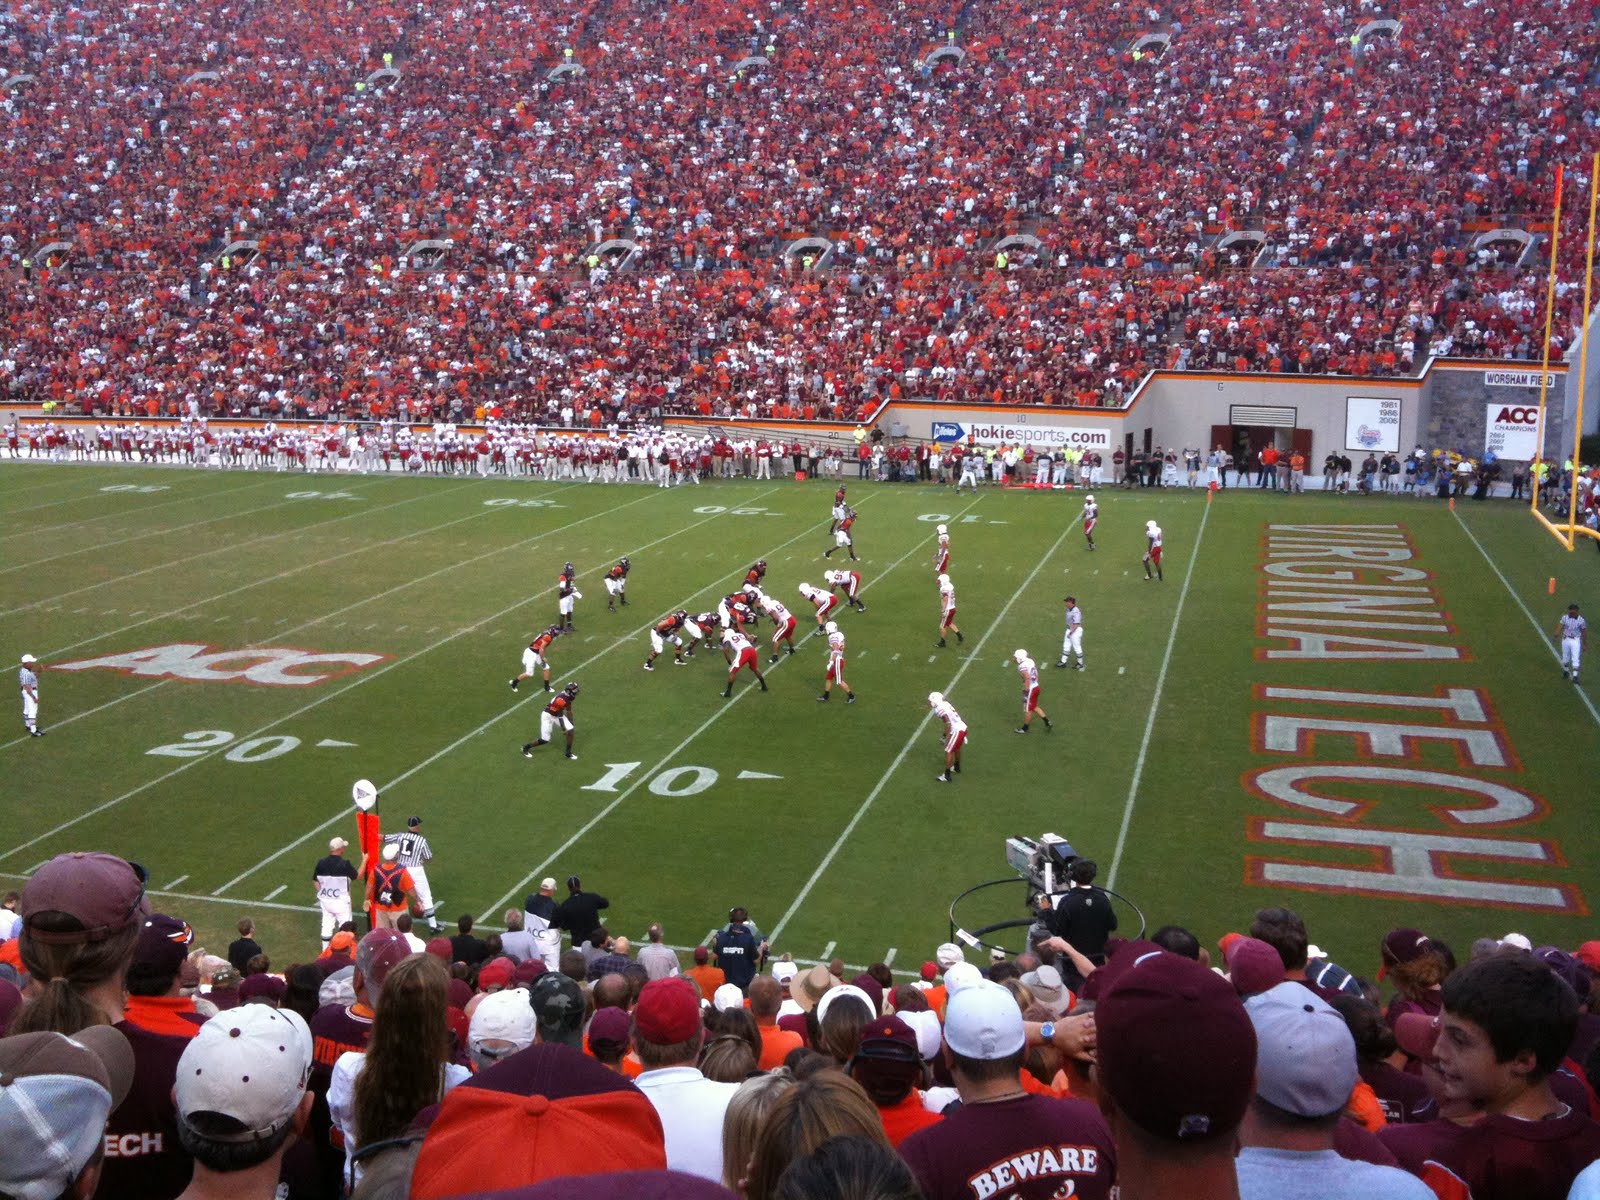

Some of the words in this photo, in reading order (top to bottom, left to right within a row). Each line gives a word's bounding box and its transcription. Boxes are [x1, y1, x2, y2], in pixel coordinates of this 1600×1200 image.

[1487, 372, 1528, 385] WORSHAM
[1530, 375, 1554, 386] FIED
[1495, 407, 1539, 425] ACC
[971, 424, 1107, 445] hokiesports.com
[1494, 424, 1537, 433] CHAMPIONS
[47, 643, 385, 686] ACC
[144, 730, 302, 763] 20
[580, 761, 720, 797] 10
[1253, 686, 1568, 909] TECH
[401, 839, 412, 856] L
[320, 887, 341, 898] ACC
[526, 927, 546, 940] ACC
[722, 946, 755, 955] ESPN
[103, 1131, 163, 1157] ECH
[969, 1146, 1099, 1200] BEWARE
